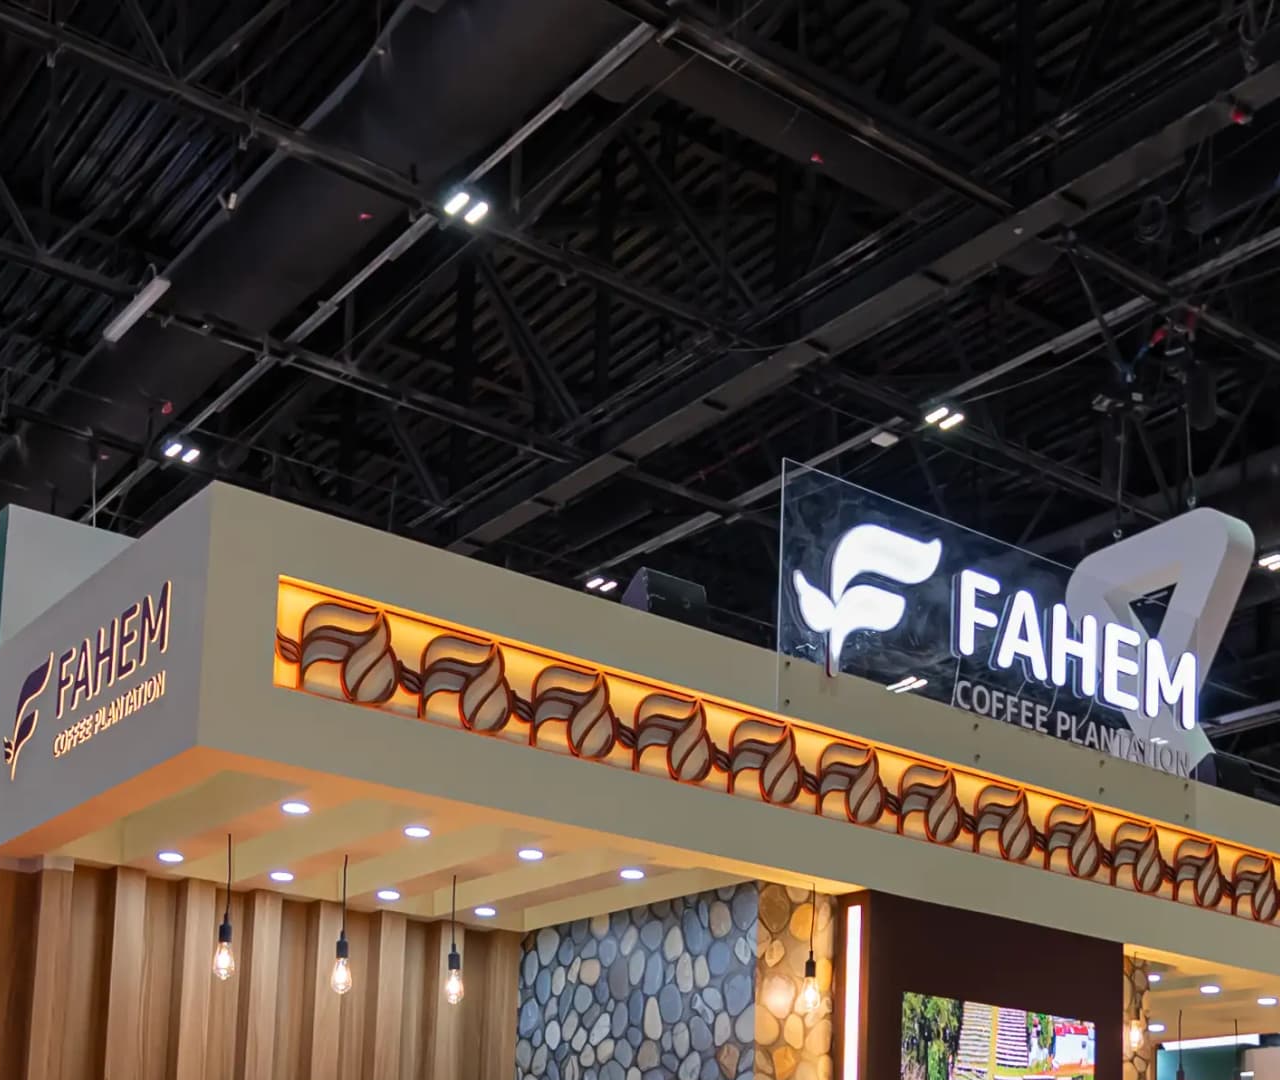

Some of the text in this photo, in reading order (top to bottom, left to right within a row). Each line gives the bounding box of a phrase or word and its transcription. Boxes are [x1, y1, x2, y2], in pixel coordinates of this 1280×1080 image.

[55, 579, 172, 720] FAHEM
[958, 568, 1197, 731] FAHEM
[52, 669, 167, 759] COFFEE PLANTATION
[955, 680, 1191, 779] COFFEE PLANTATION
